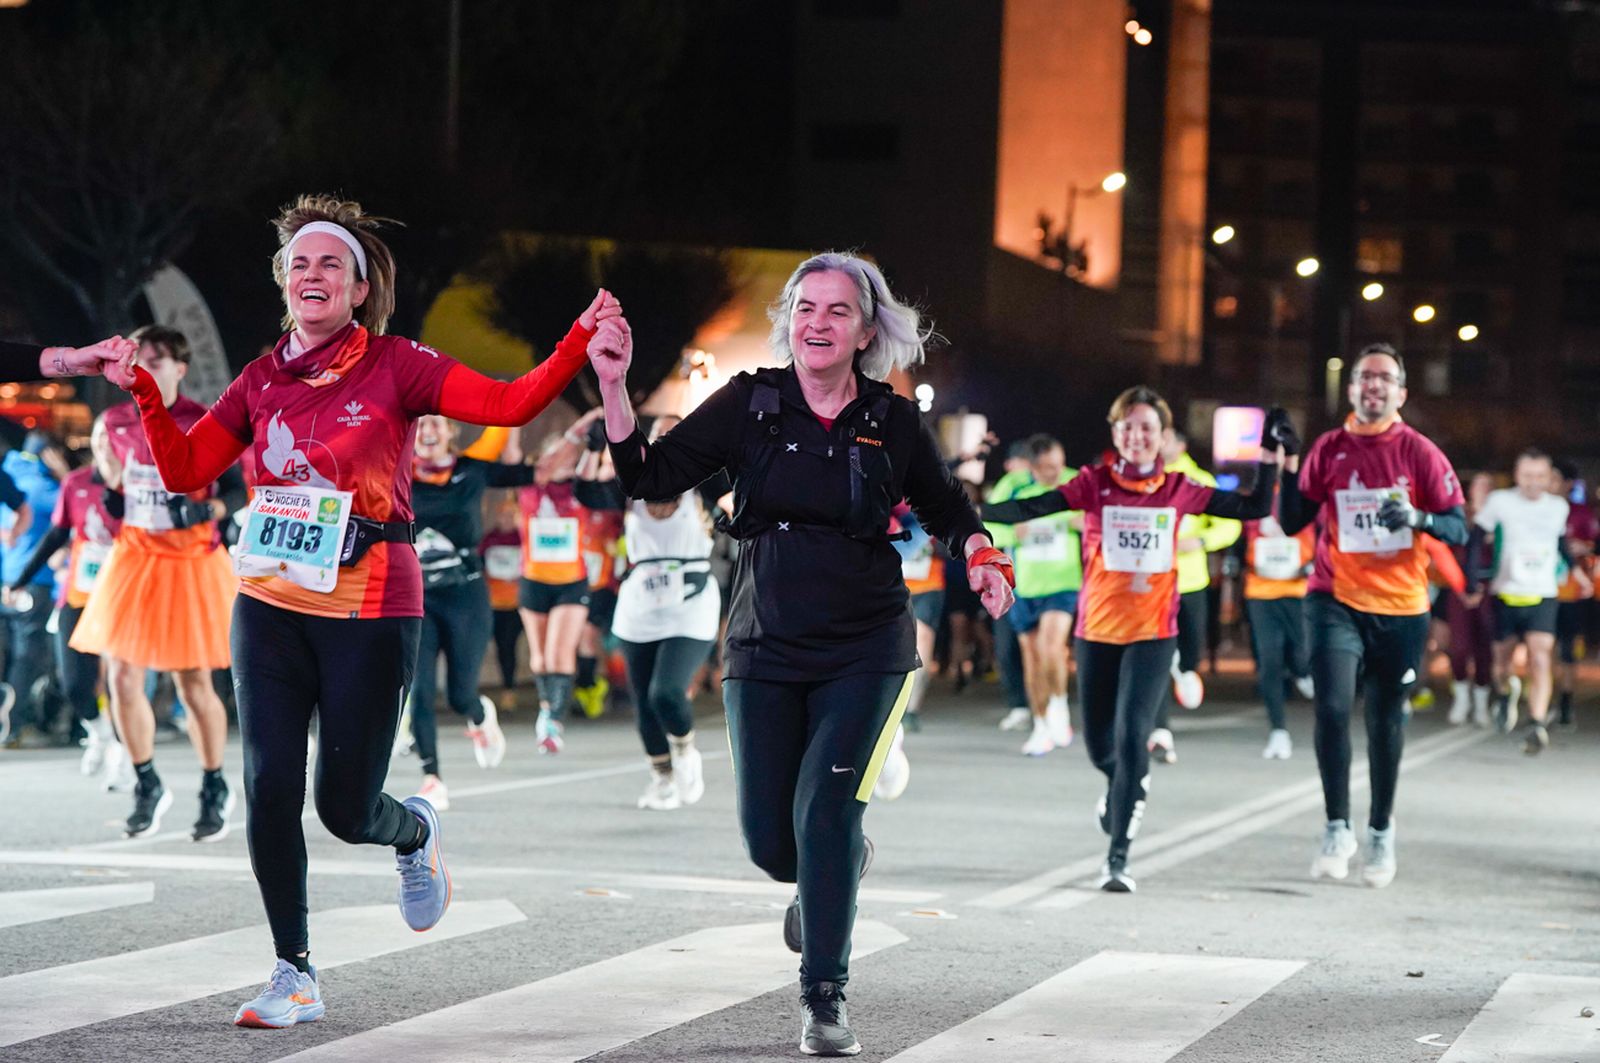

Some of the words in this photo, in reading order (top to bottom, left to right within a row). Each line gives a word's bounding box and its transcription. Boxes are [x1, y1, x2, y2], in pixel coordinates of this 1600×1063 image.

[282, 458, 311, 482] 43
[258, 504, 279, 516] SAN
[275, 495, 301, 507] NOCHE
[1354, 513, 1384, 531] 414
[259, 516, 323, 554] 8193
[1118, 531, 1160, 550] 5521
